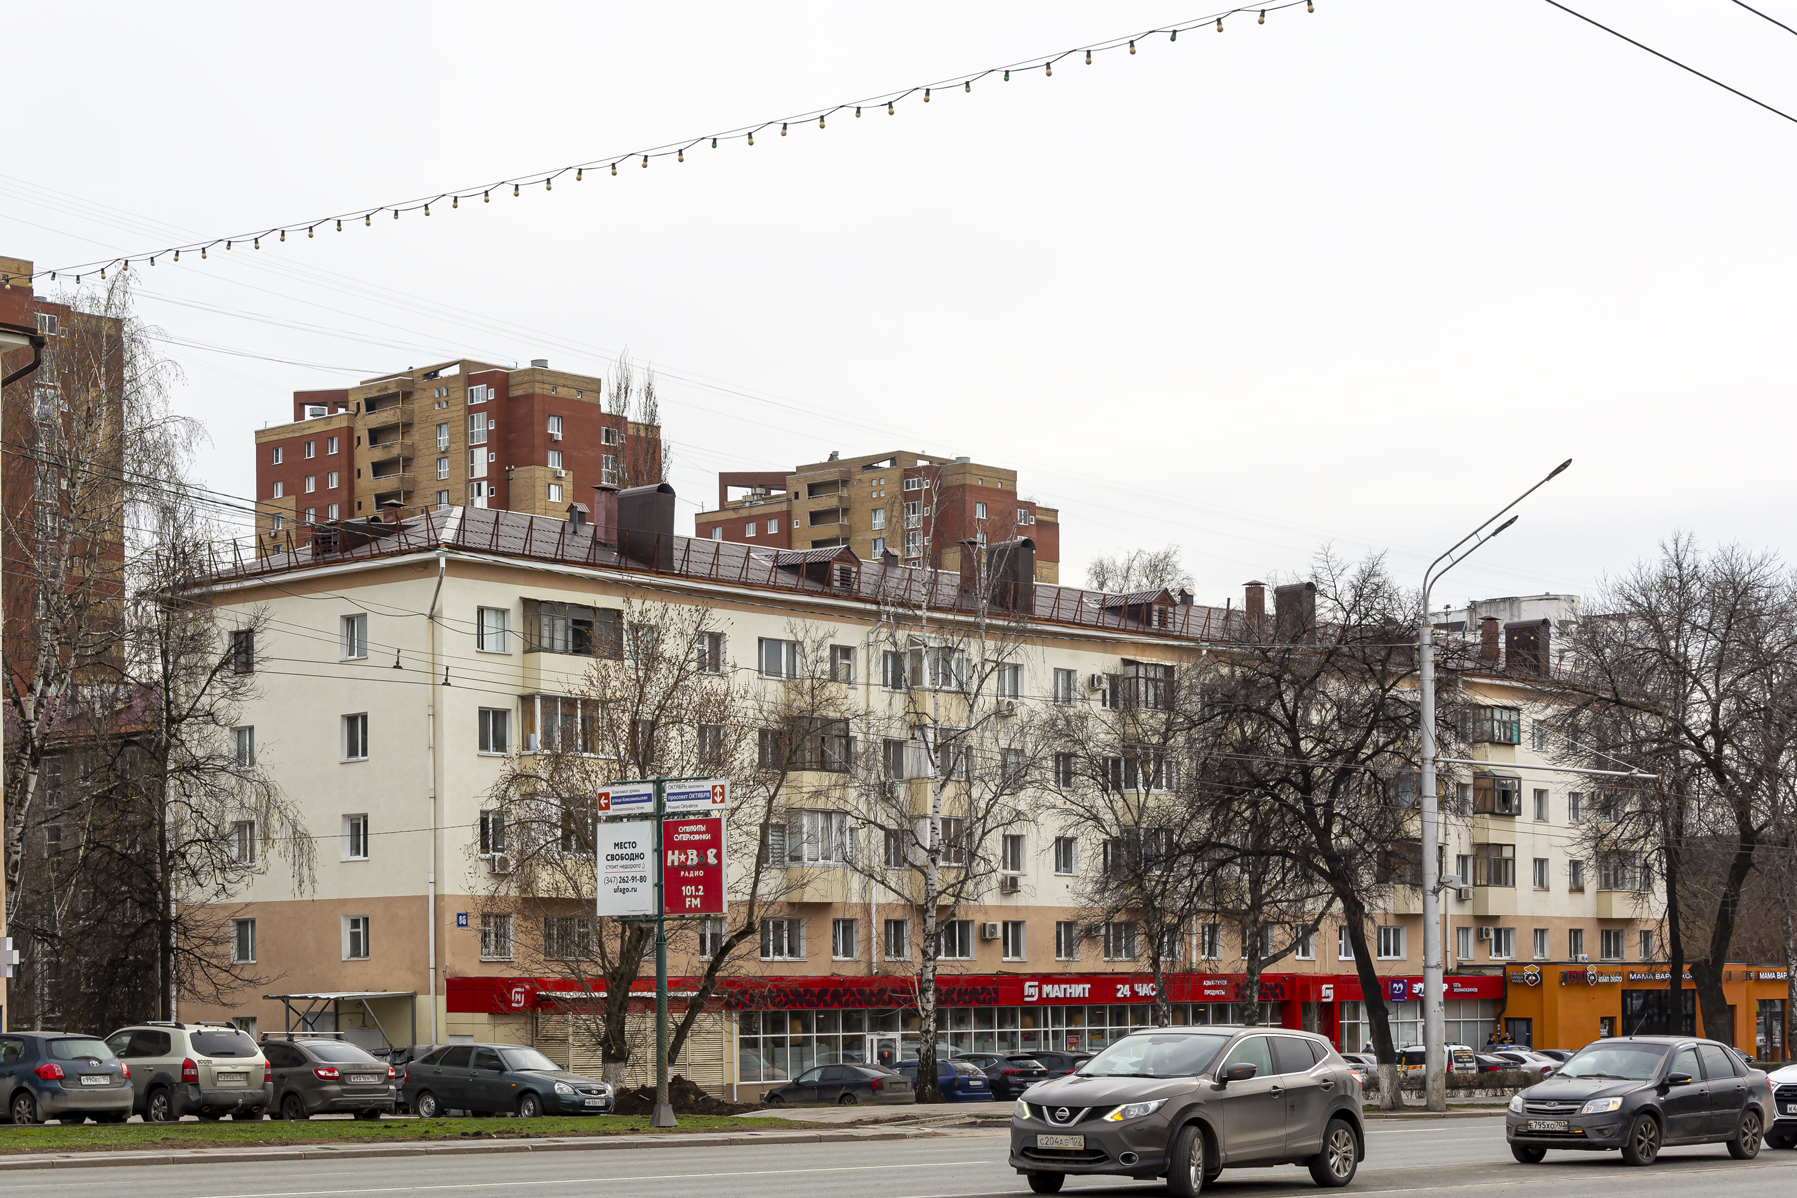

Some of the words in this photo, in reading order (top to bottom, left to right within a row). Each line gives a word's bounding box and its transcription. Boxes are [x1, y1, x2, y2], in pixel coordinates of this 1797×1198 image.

[613, 841, 637, 850] МЕСТО
[605, 852, 645, 861] СВОБОДНО
[603, 875, 618, 886] (347)
[618, 875, 647, 884] 262-91-80
[613, 885, 638, 895] ufago.ru
[681, 885, 704, 896] 101.2
[685, 897, 701, 909] FM
[1041, 984, 1091, 998] МАГНИТ
[1116, 984, 1131, 998] 24
[1133, 983, 1157, 997] ЧАС
[1040, 1136, 1069, 1146] С204АЕ
